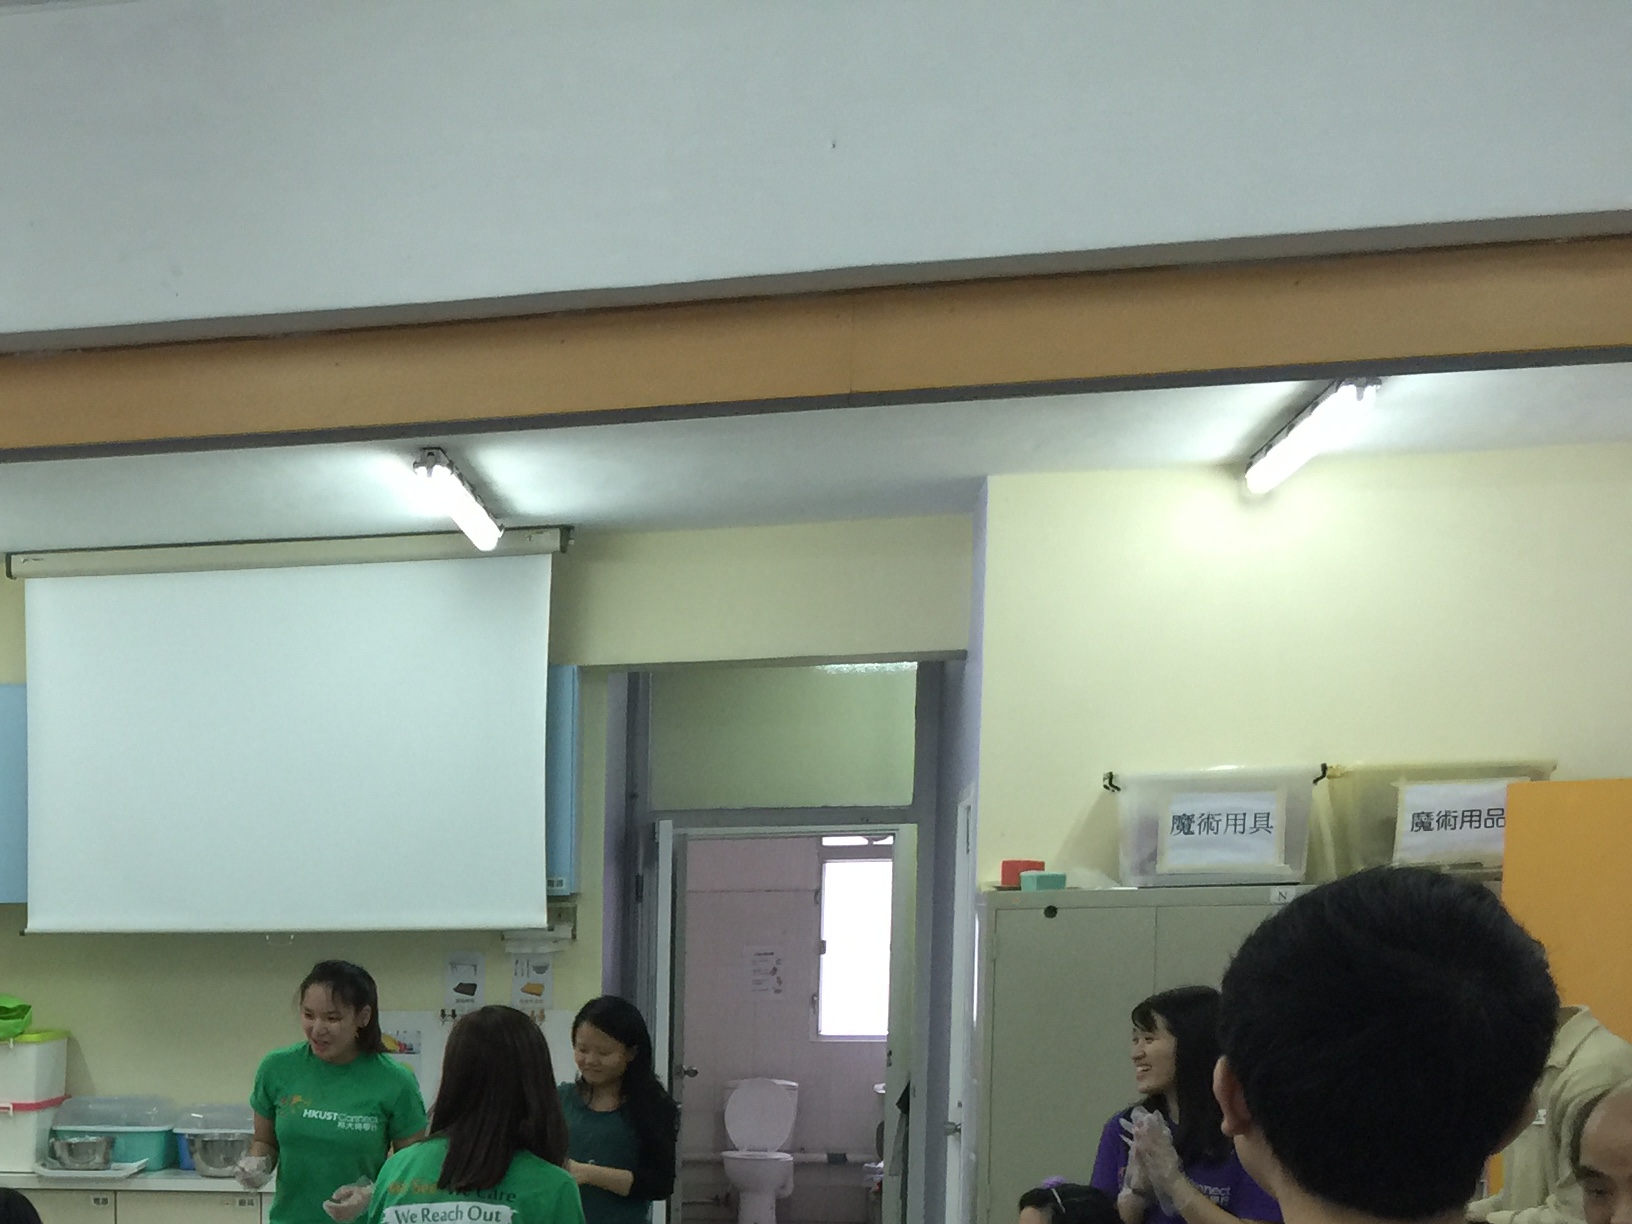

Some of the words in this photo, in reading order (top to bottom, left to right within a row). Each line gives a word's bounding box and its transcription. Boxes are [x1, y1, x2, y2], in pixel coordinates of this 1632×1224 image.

[1170, 811, 1275, 837] 魔術用具
[1410, 807, 1506, 833] 魔術用品
[394, 1209, 418, 1224] We
[421, 1204, 464, 1224] Reach
[468, 1205, 502, 1223] Out
